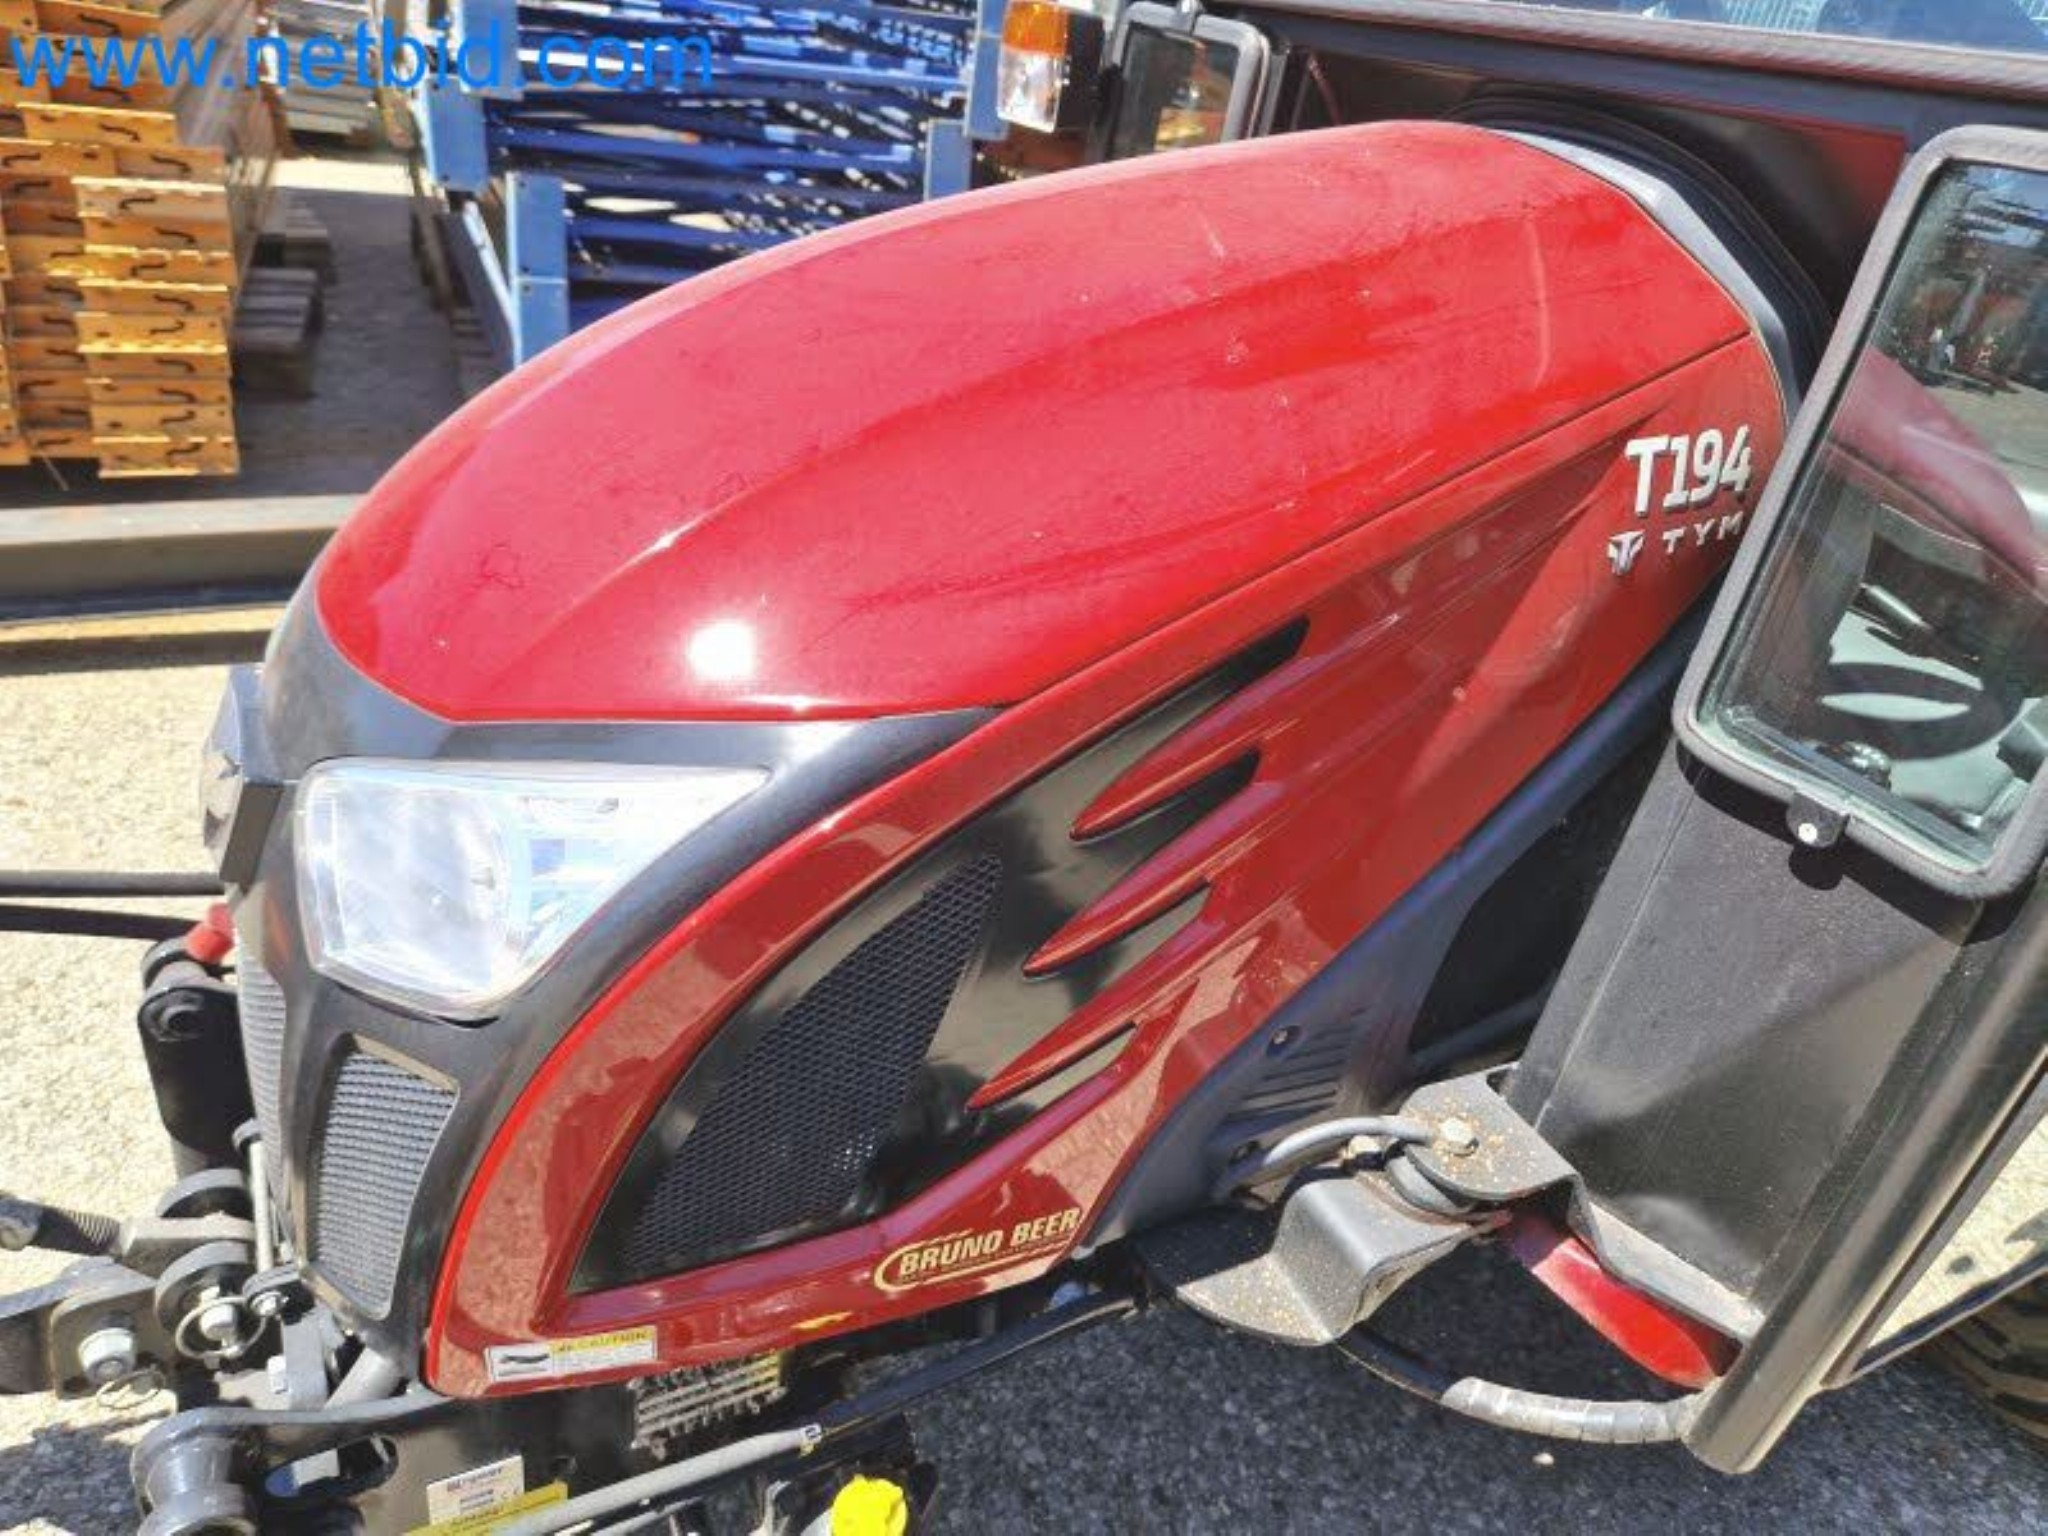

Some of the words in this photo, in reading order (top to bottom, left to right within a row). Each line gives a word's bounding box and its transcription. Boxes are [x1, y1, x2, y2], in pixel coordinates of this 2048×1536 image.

[1624, 424, 1751, 517] T194
[1662, 511, 1744, 554] TYM
[899, 1229, 1004, 1276] BRUNO
[1010, 1207, 1081, 1247] BEER
